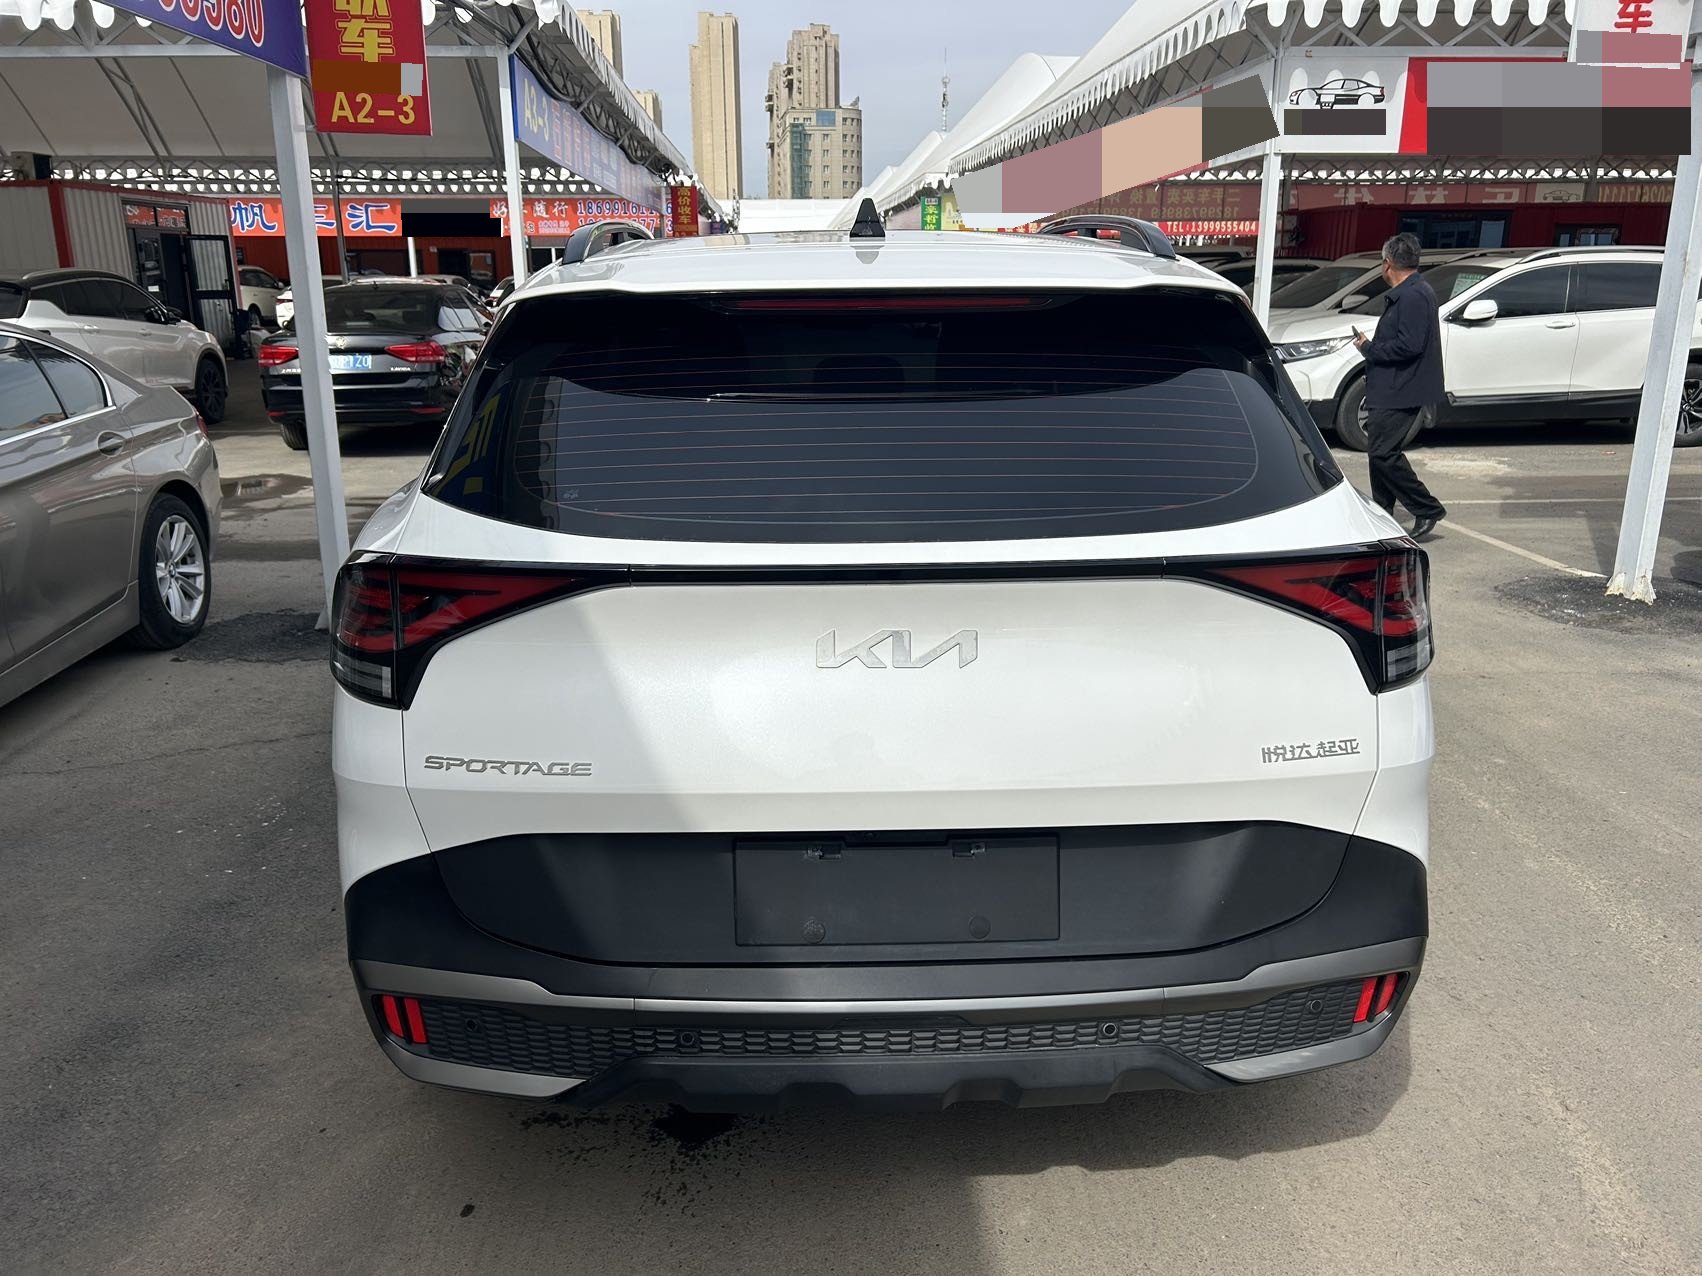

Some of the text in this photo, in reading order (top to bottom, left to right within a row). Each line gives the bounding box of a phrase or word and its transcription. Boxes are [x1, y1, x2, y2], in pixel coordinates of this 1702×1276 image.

[331, 91, 416, 124] A2-3
[816, 629, 978, 668] KIA
[1261, 738, 1360, 763] 悦达起亚
[424, 755, 592, 776] SPORTAGE
